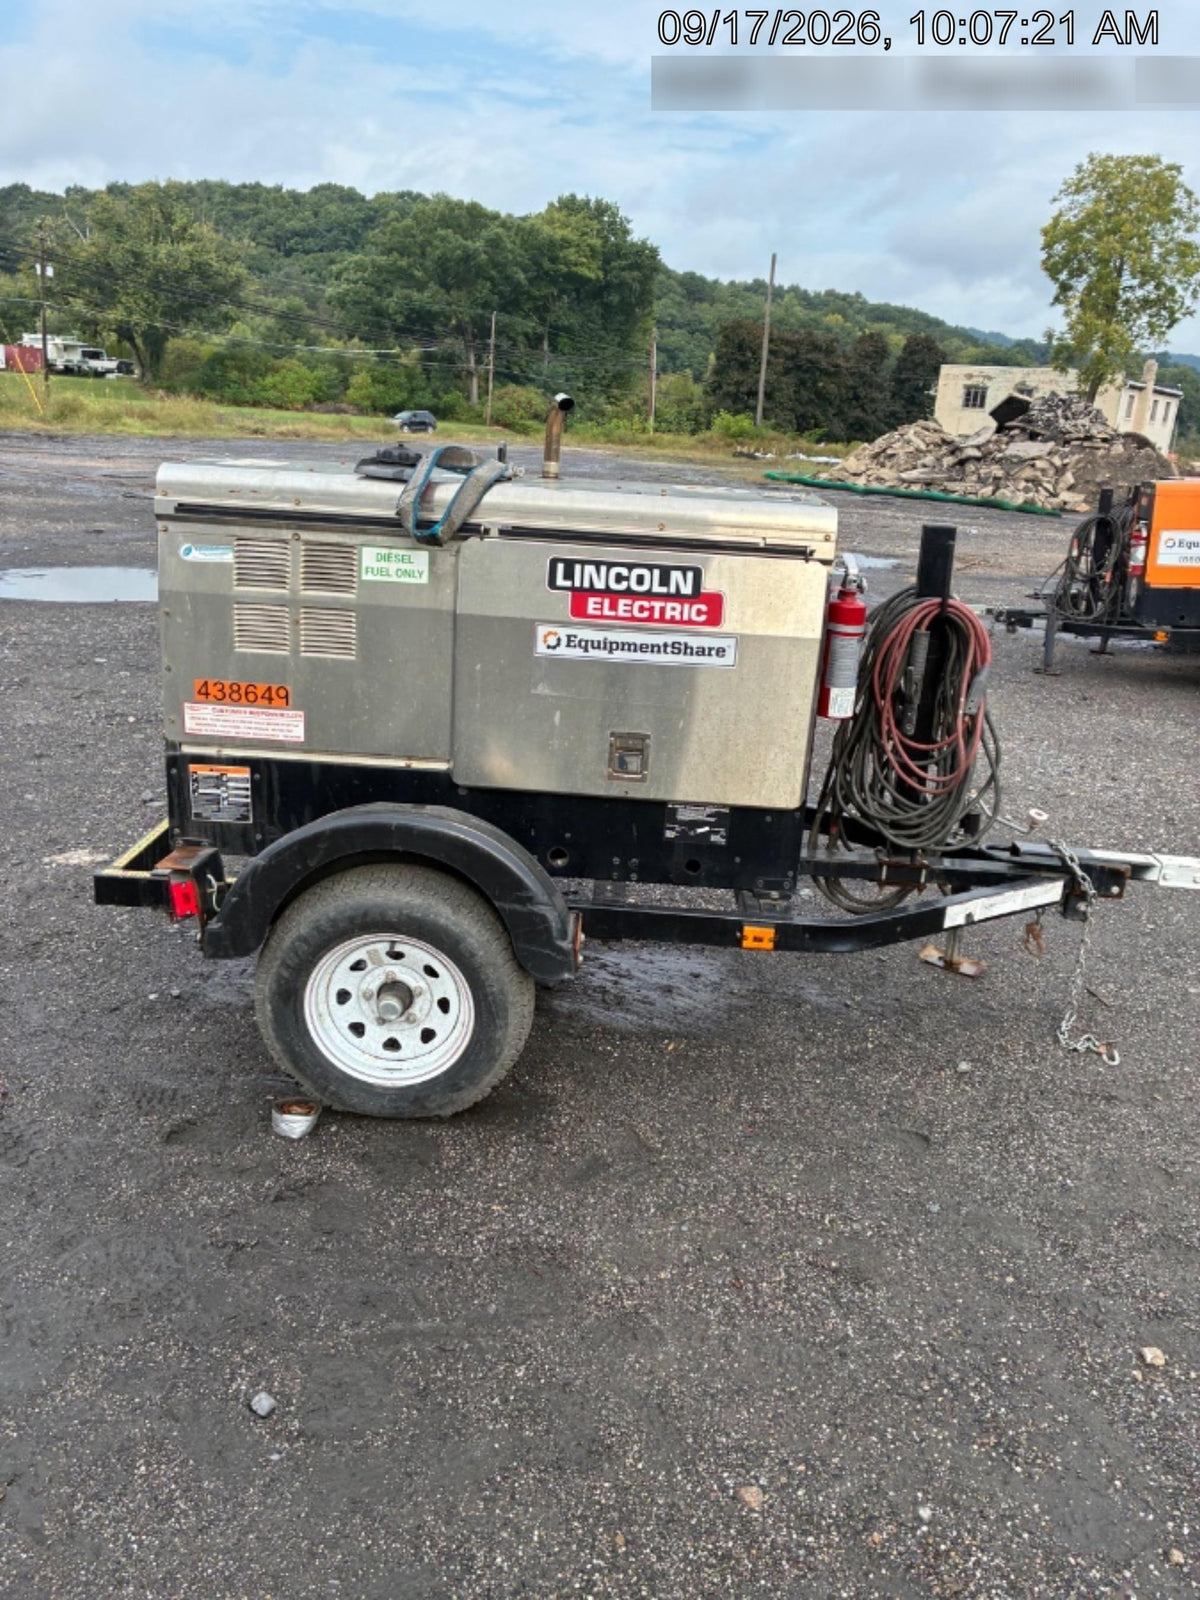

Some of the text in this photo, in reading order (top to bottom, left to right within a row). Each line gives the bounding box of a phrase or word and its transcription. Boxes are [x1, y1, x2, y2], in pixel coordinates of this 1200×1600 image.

[376, 552, 414, 564] DIESEL
[365, 566, 424, 579] FUEL ONLY
[555, 562, 694, 595] LINCOLN
[586, 597, 708, 622] ELECTRIC
[565, 633, 727, 659] EquipmentShare
[196, 680, 289, 706] 438649
